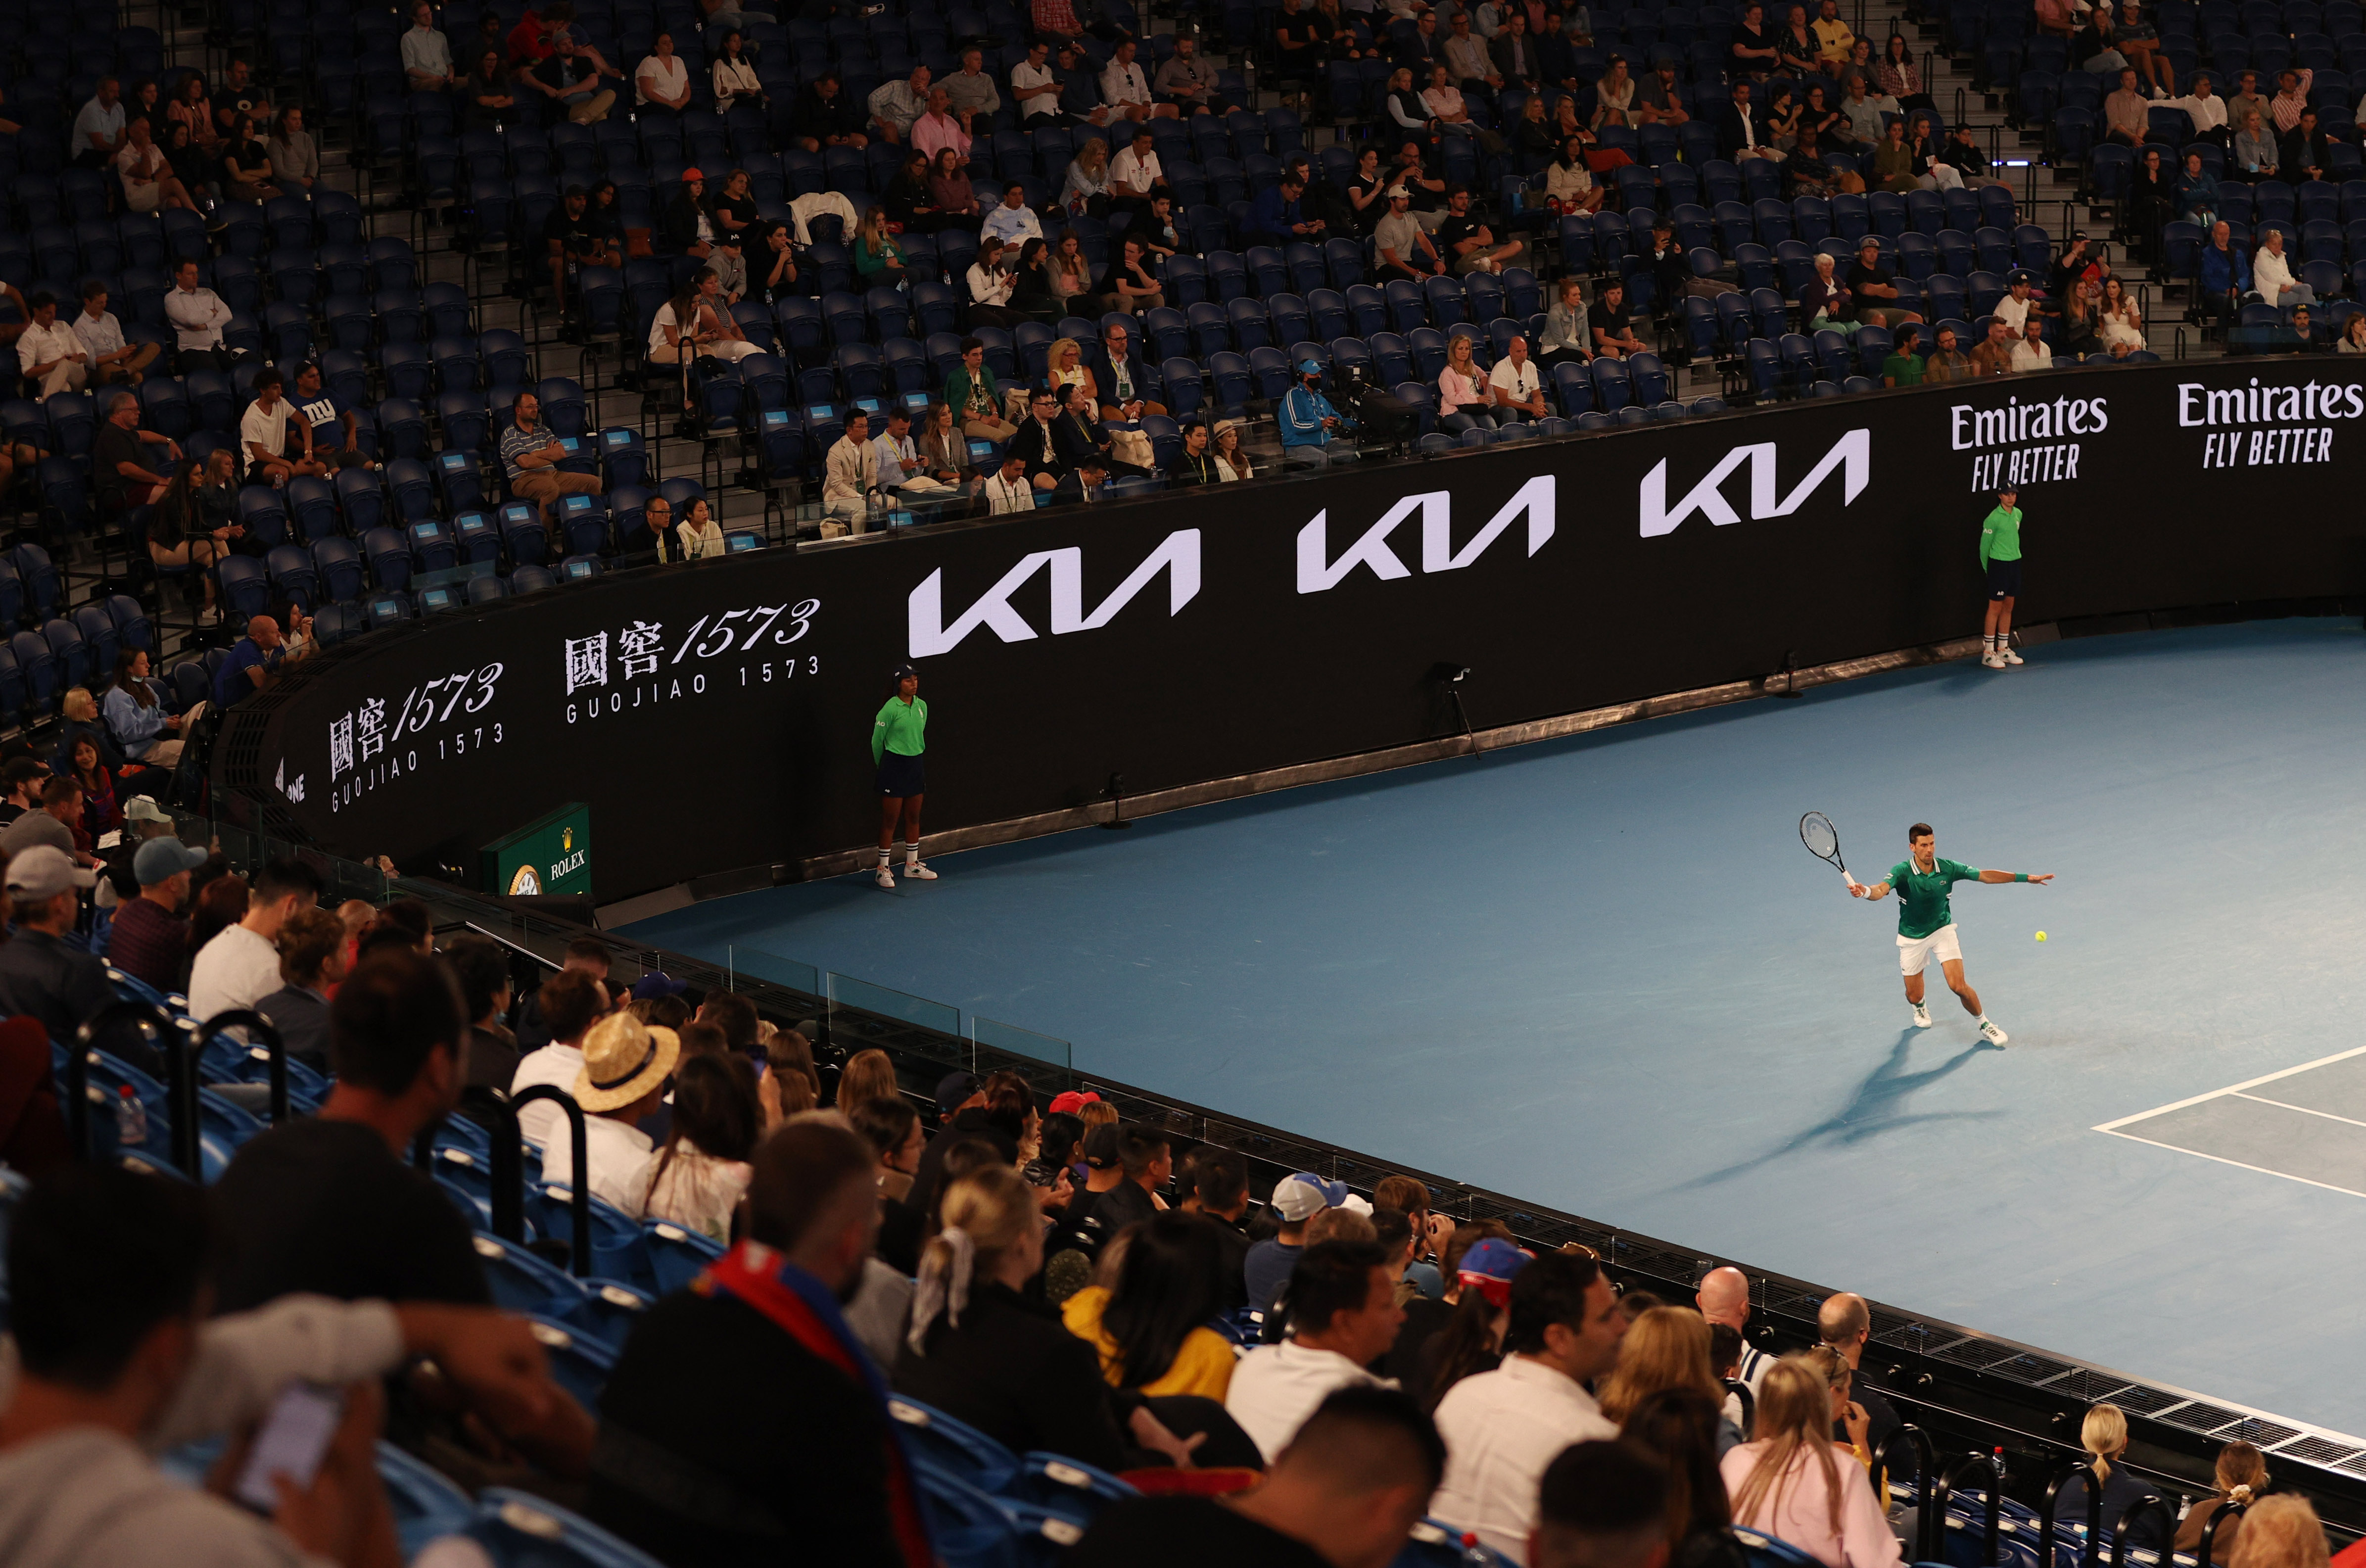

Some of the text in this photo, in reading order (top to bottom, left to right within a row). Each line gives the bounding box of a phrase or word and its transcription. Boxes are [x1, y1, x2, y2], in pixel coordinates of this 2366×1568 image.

[1951, 394, 2108, 451] Emirates
[2177, 377, 2364, 427] Emirates
[1972, 443, 2080, 492] FLY BETTER
[2203, 428, 2333, 469] FLY BETTER
[1640, 428, 1870, 538] KIA
[1297, 475, 1555, 594] KIA
[908, 528, 1201, 659] KIA
[567, 656, 818, 723] GUOJIAO 1573
[332, 723, 503, 813] GUOJIAO 1573
[551, 849, 585, 881] ROLEX
